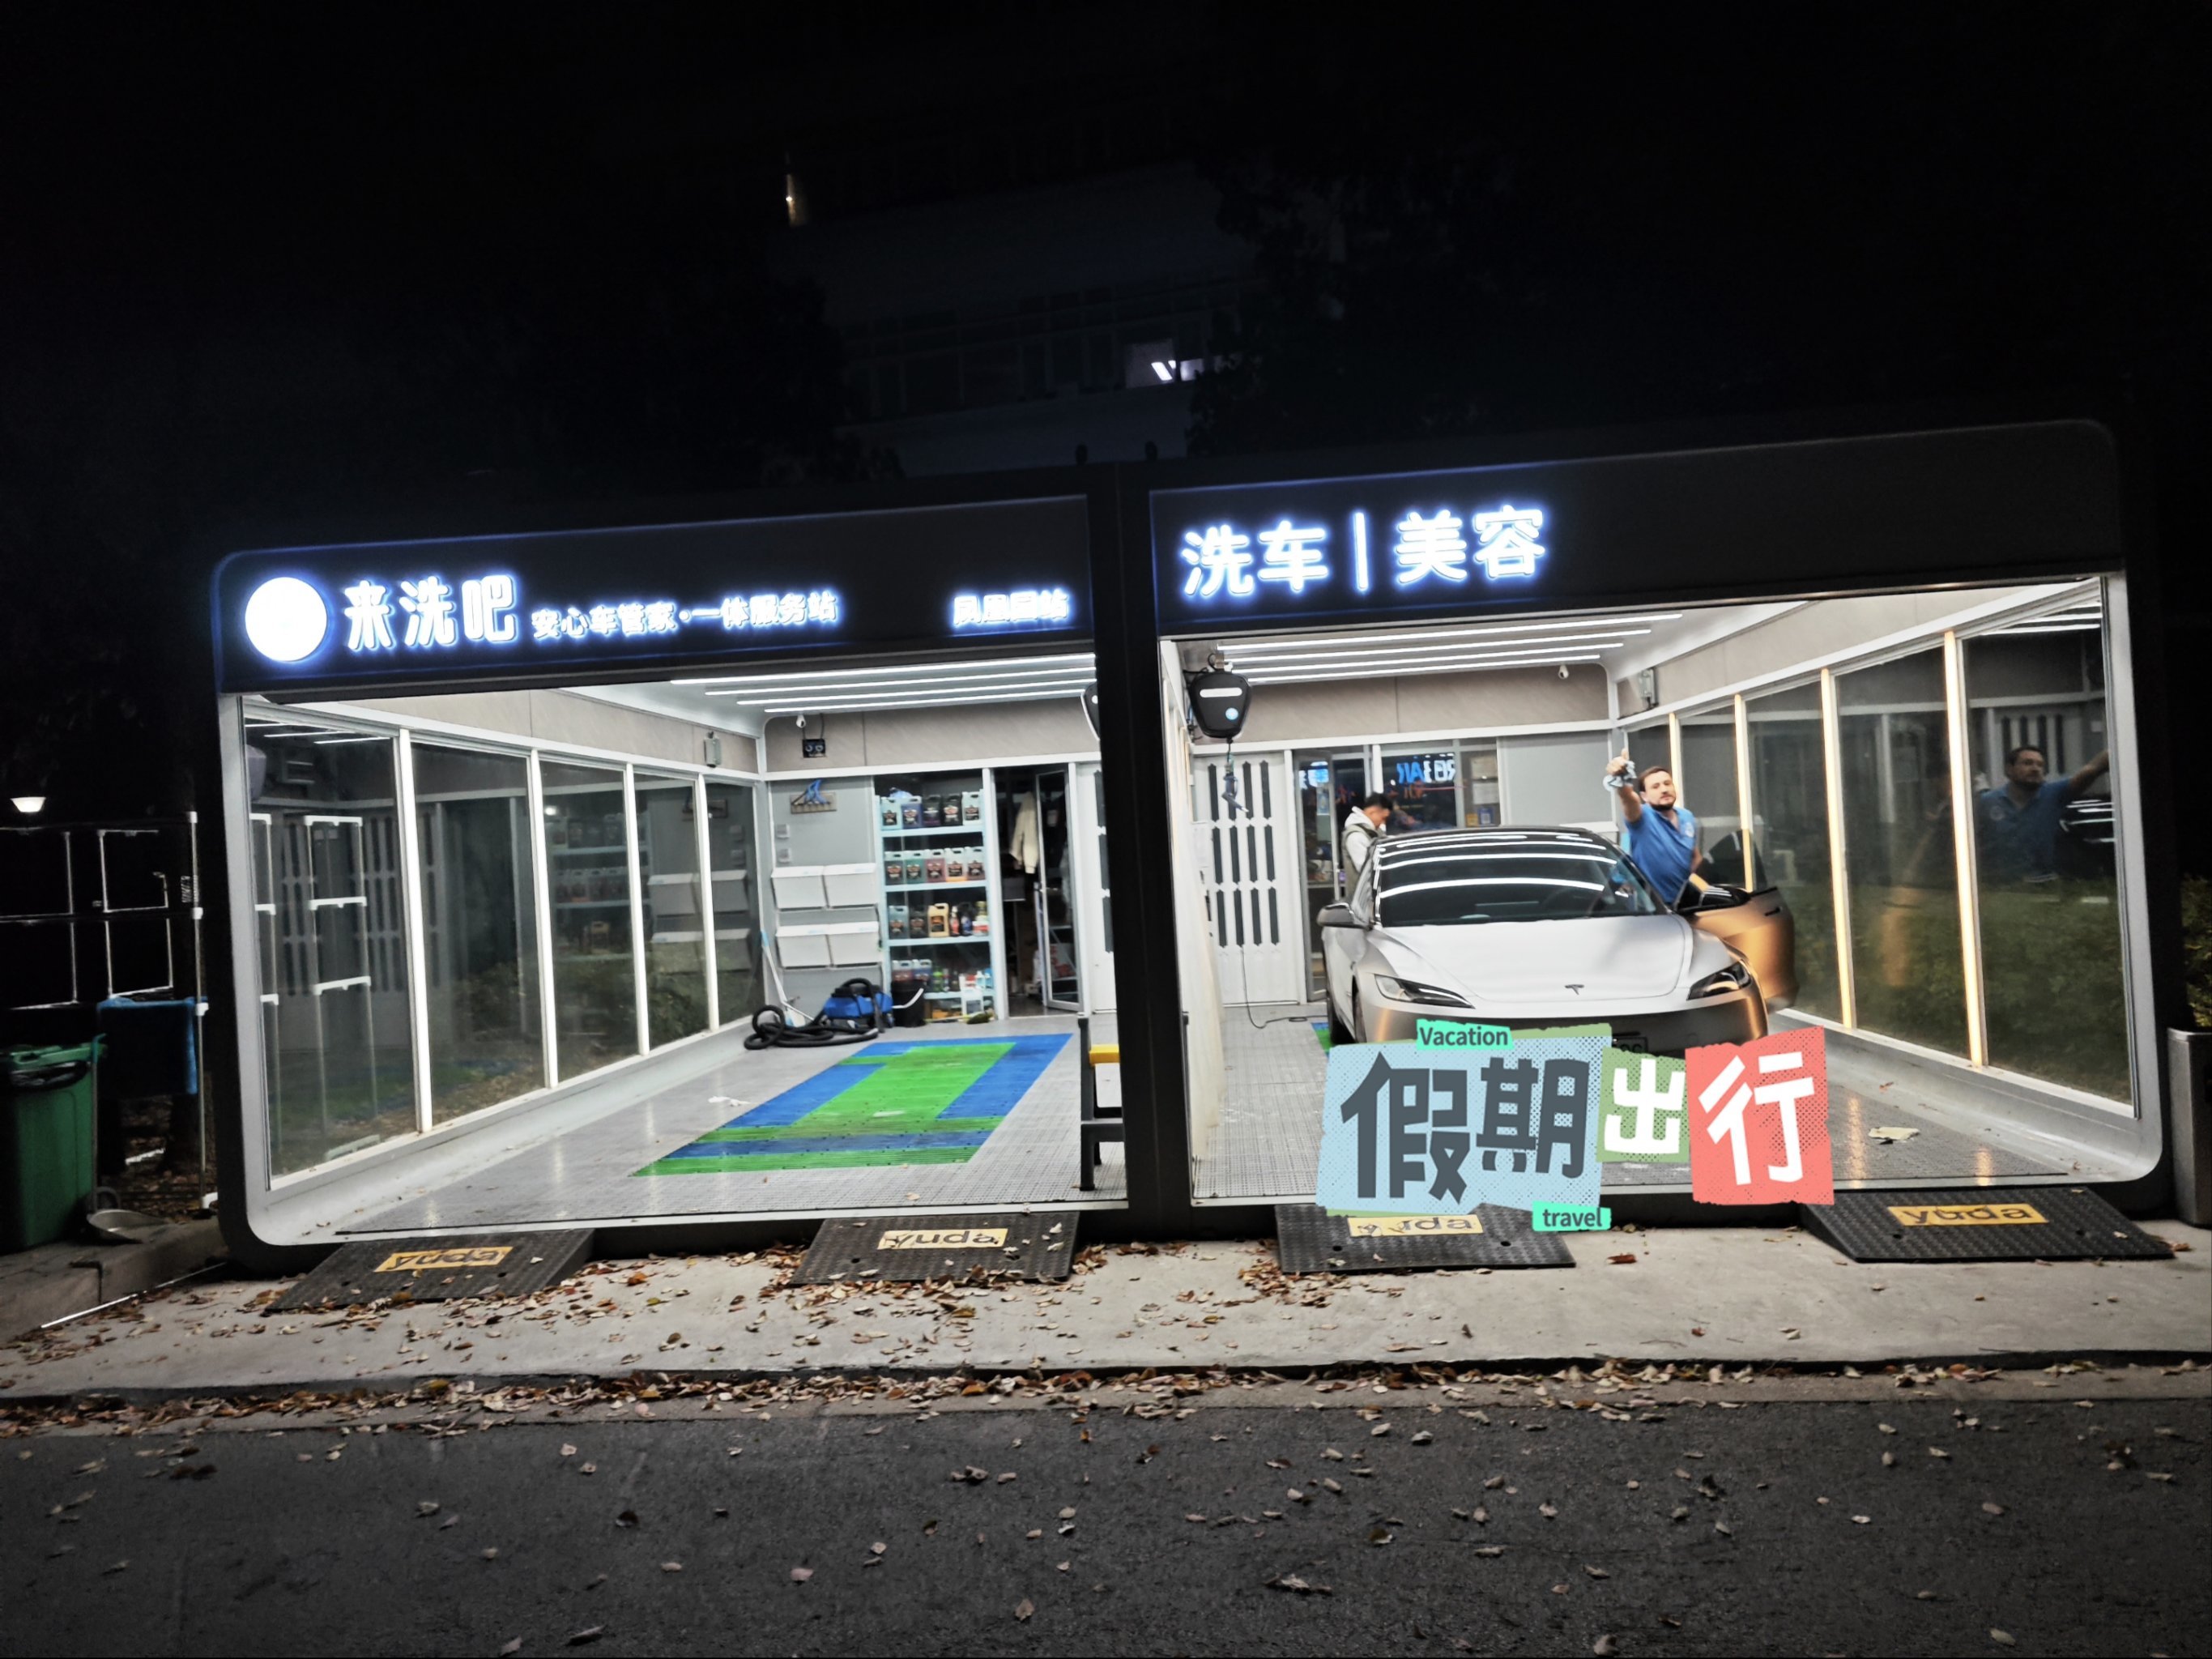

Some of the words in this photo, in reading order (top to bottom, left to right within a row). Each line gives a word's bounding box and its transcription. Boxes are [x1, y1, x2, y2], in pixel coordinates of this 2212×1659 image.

[1182, 521, 1328, 596] 洗车
[1396, 504, 1545, 584] 美容
[344, 575, 517, 650] 来洗吧
